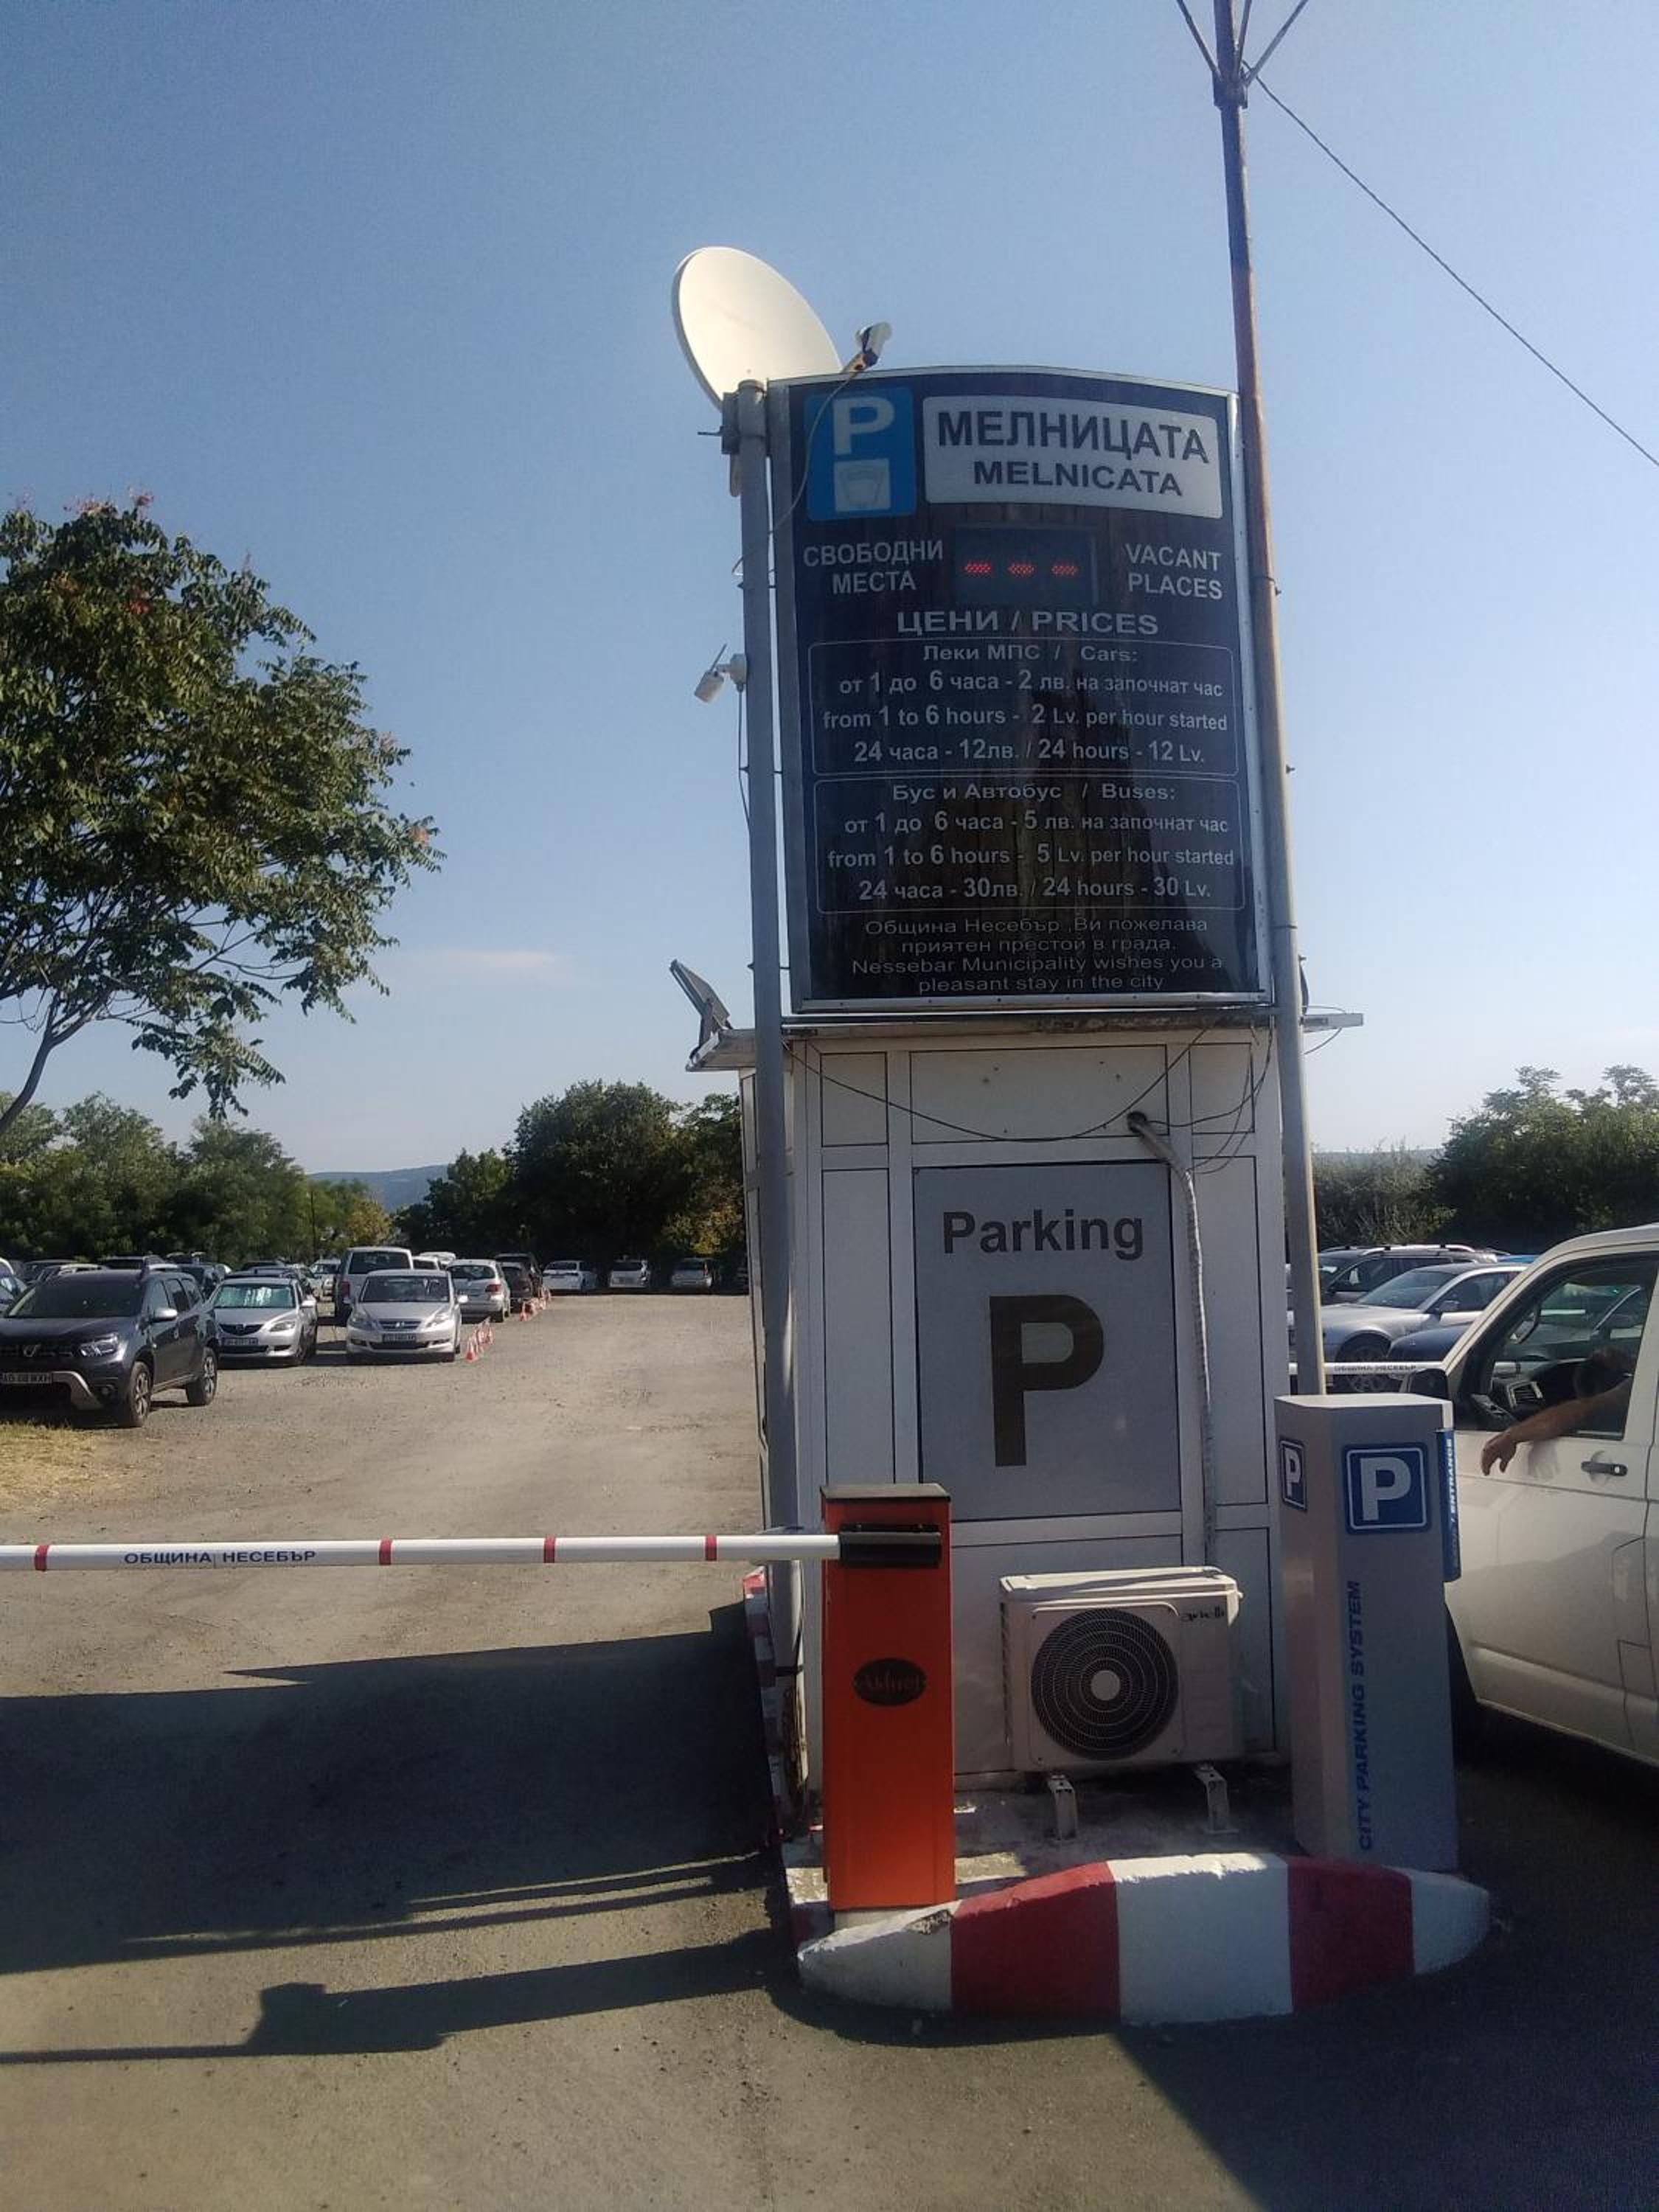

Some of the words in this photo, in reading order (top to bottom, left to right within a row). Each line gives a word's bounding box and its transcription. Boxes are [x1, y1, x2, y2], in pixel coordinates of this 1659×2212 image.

[833, 396, 895, 456] P
[938, 411, 1209, 464] МЕЛНИЦАТА
[974, 461, 1183, 496] MELNICATA
[803, 540, 943, 567] СВОБОДНИ
[1126, 543, 1222, 571] VACANT
[833, 571, 917, 594] МЕСТА
[1129, 573, 1222, 600] PLACES
[897, 611, 998, 636] ЦЕНИ
[1032, 612, 1158, 635] PRICES
[923, 646, 978, 661] Леки
[988, 645, 1039, 659] МПС
[1080, 646, 1138, 661] Cars:
[840, 680, 863, 694] от
[871, 672, 880, 692] 1
[889, 678, 917, 694] до
[930, 670, 943, 689] 6
[950, 676, 998, 689] часа
[1019, 669, 1032, 689] 2
[1040, 678, 1069, 690] лв.
[1077, 678, 1098, 690] на
[1104, 678, 1189, 694] започнат
[1194, 682, 1223, 697] час
[823, 711, 871, 728] from
[880, 706, 888, 726] 1
[898, 709, 919, 726] to
[926, 705, 939, 725] 6
[947, 706, 1006, 724] hours
[1032, 704, 1045, 723] 2
[1054, 708, 1079, 724] Lv.
[1087, 711, 1116, 727] per
[1122, 709, 1165, 726] hour
[1169, 713, 1228, 731] started
[855, 741, 883, 762] 24
[889, 745, 938, 761] часа
[1038, 739, 1065, 759] 24
[1073, 742, 1130, 759] hours
[1149, 740, 1173, 761] 12
[1180, 746, 1204, 762] Lv.
[893, 785, 936, 804] Бус
[943, 787, 956, 799] и
[965, 784, 1062, 801] Автобус
[1102, 784, 1175, 800] Buses:
[845, 820, 868, 834] от
[875, 813, 885, 832] 1
[894, 817, 922, 834] до
[935, 811, 947, 831] 6
[956, 817, 1004, 830] часа
[1024, 810, 1037, 830] 5
[1044, 817, 1074, 830] лв.
[1082, 816, 1104, 830] на
[1110, 816, 1194, 832] започнат
[1200, 819, 1228, 832] час
[827, 850, 876, 867] from
[885, 846, 894, 865] 1
[903, 849, 924, 865] to
[931, 845, 944, 864] 6
[951, 847, 1010, 864] hours
[1037, 844, 1050, 863] 5
[1058, 847, 1085, 862] Lv.
[1091, 850, 1121, 866] per
[1128, 847, 1170, 863] hour
[1175, 849, 1234, 865] started
[859, 880, 887, 900] 24
[894, 885, 943, 899] часа
[1043, 877, 1070, 896] 24
[1078, 880, 1134, 896] hours
[1154, 877, 1178, 896] 30
[1186, 881, 1210, 897] Lv.
[866, 921, 956, 936] Община
[965, 920, 1060, 934] Несебър
[1109, 919, 1207, 932] пожелава
[902, 941, 990, 956] приятен
[999, 936, 1085, 953] престой
[852, 959, 954, 975] Nessebar
[963, 957, 1086, 973] Municipality
[1095, 956, 1163, 970] wishes
[1170, 959, 1204, 972] you
[1212, 959, 1222, 968] a
[919, 978, 1009, 995] pleasant
[1017, 977, 1058, 992] stay
[1068, 975, 1083, 988] in
[1092, 975, 1122, 988] the
[1130, 975, 1164, 990] city
[943, 1208, 1143, 1262] Parking
[990, 1294, 1104, 1467] P
[1284, 1447, 1301, 1499] P
[1446, 1439, 1456, 1513] ENTRANCE
[1360, 1457, 1411, 1521] P
[124, 1552, 212, 1565] ОБЩИНА
[223, 1551, 316, 1563] НЕСЕБЪР
[1347, 1580, 1366, 1675] SYSTEM
[1351, 1683, 1369, 1794] PARKING
[1357, 1798, 1372, 1851] CITY
